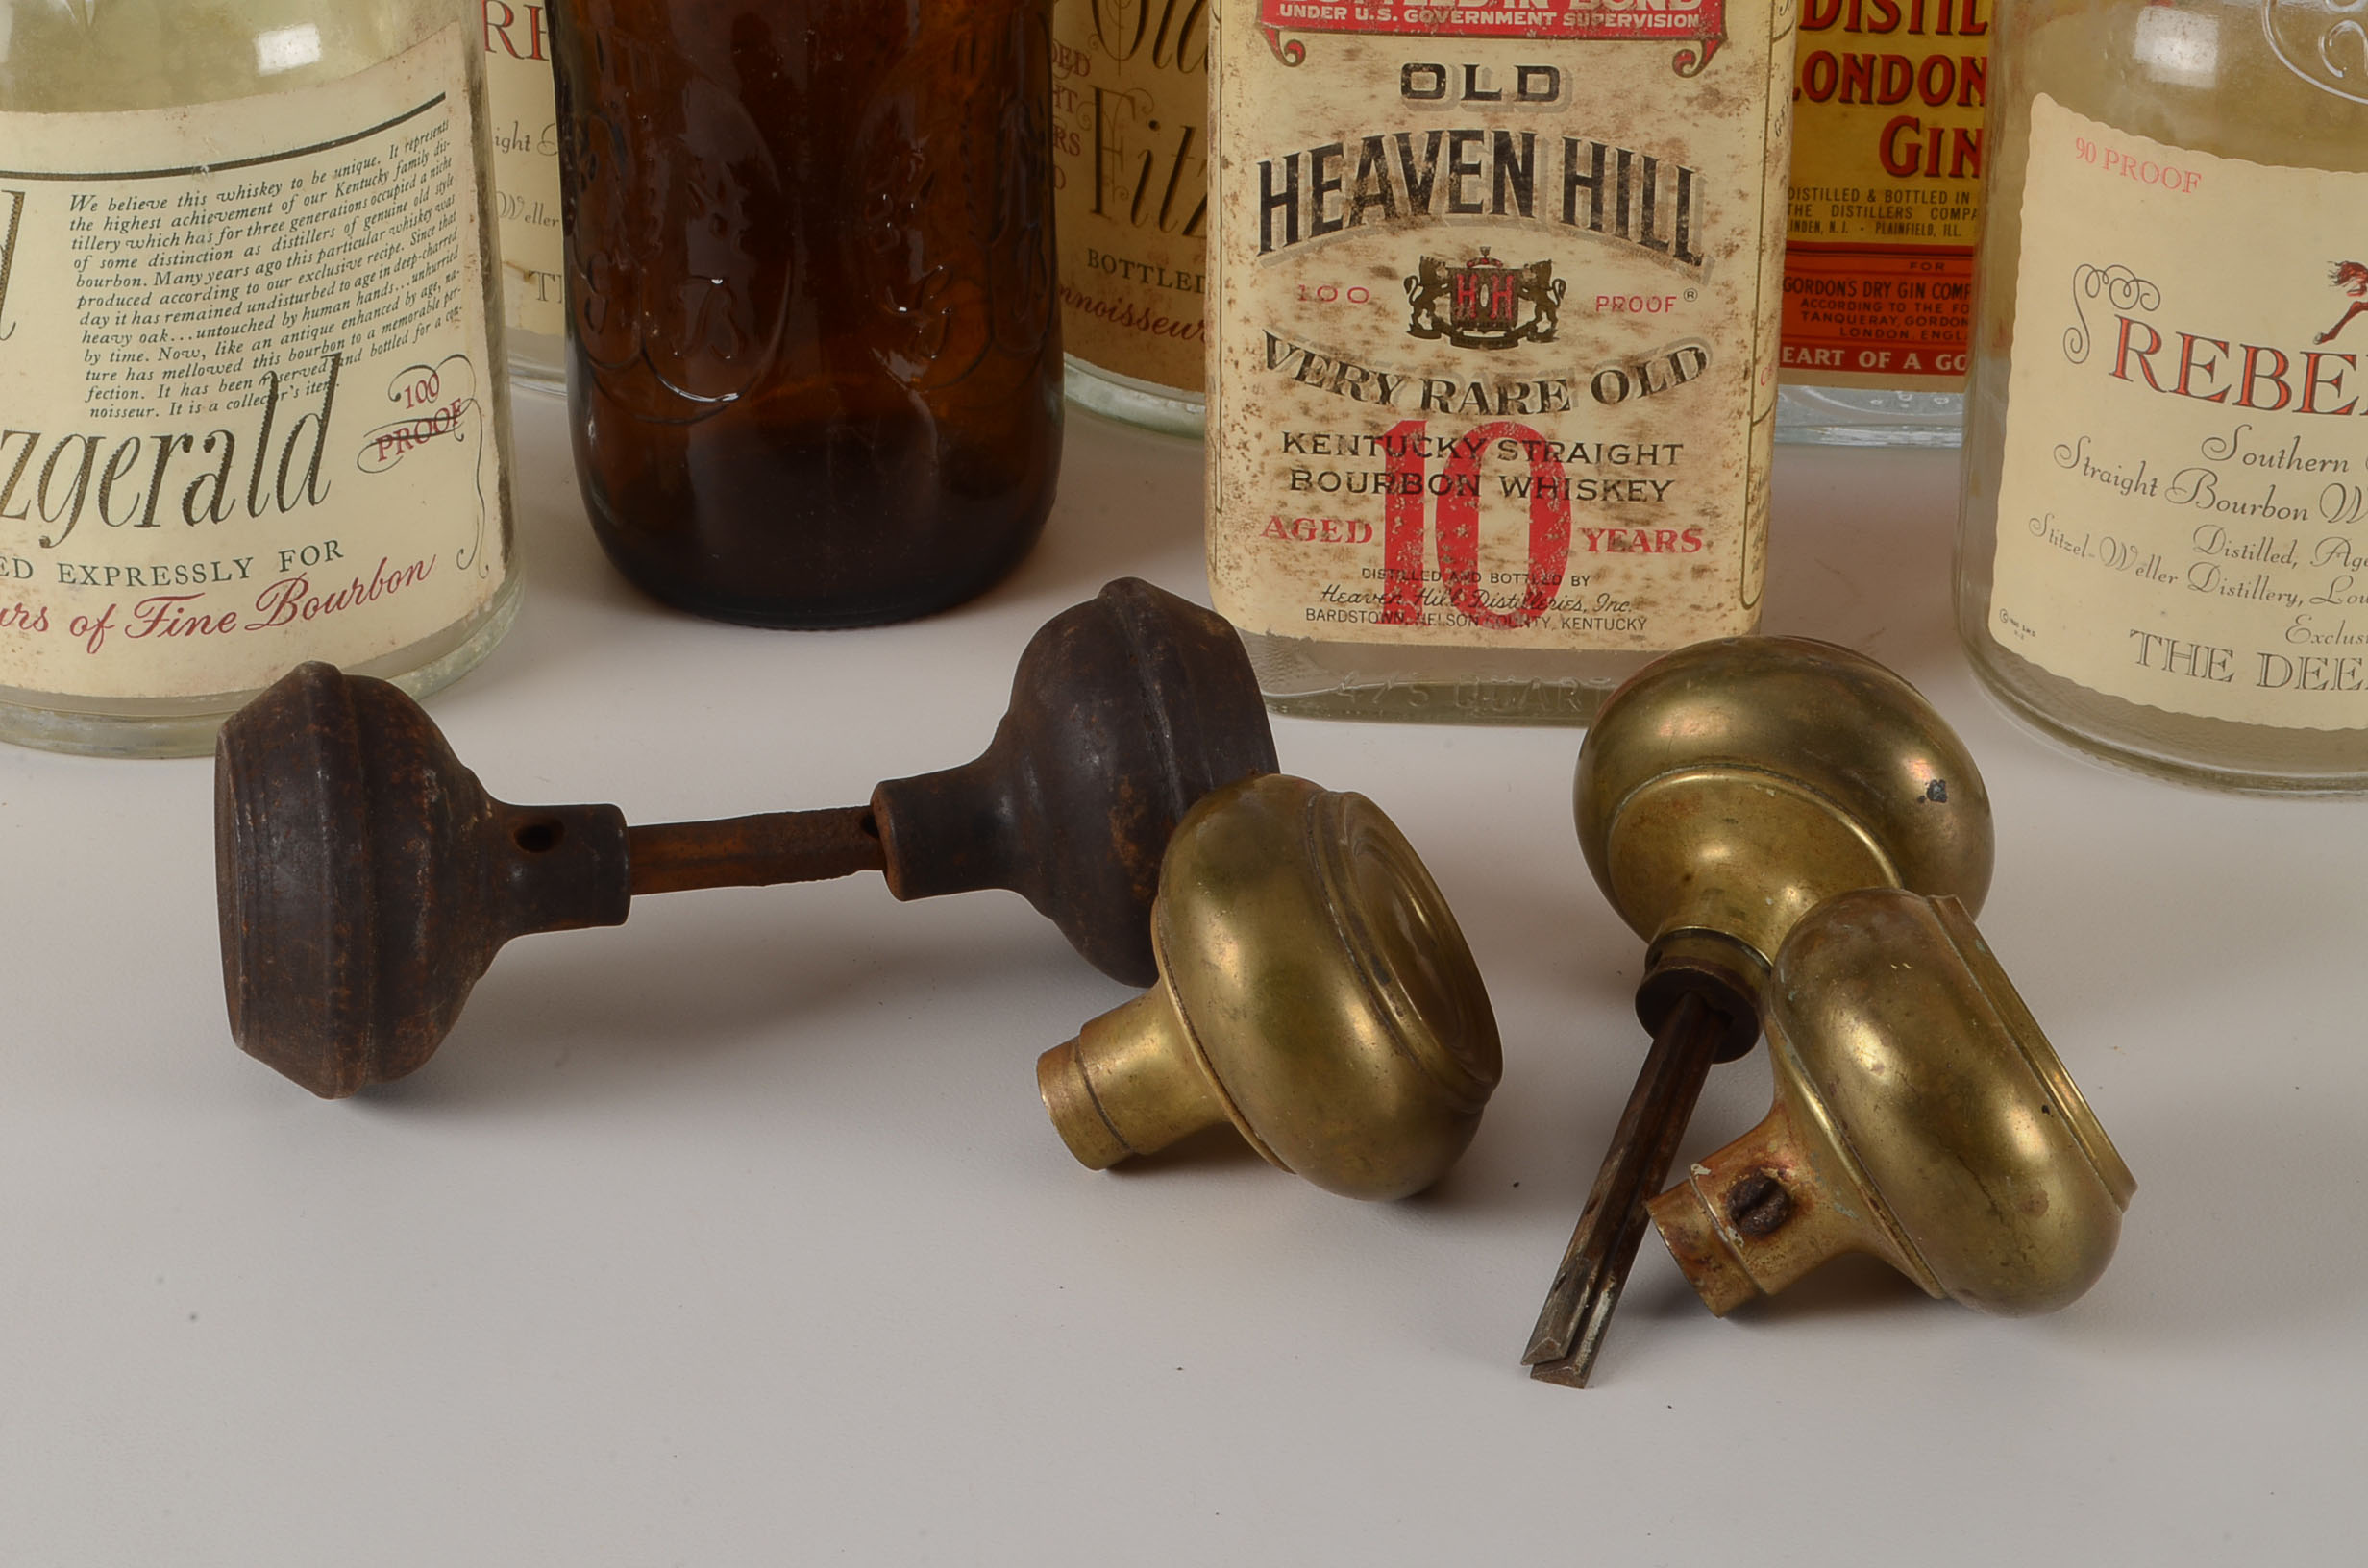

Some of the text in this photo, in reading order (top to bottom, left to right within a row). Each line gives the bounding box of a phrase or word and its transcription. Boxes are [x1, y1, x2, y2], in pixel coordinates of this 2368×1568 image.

[1279, 4, 1347, 20] UNDER
[1355, 8, 1398, 22] U.S.
[1403, 9, 1557, 26] GOVERNMENT
[1563, 12, 1700, 28] SUPERVISION
[1400, 62, 1561, 103] OLD
[1793, 50, 1987, 108] ONDON
[69, 119, 449, 212] We believe this whiskey be unique. represents
[2074, 137, 2203, 193] 90 PROOF
[69, 149, 429, 234] the highest achievement of our Kentucky family
[71, 174, 415, 253] tillery which has for three generations occupied
[1256, 129, 1703, 267] HEAVEN HILL
[1788, 187, 1969, 205] DISTILLED & BOTTLED IN
[1788, 205, 1912, 219] THE DISTILLERS
[74, 189, 429, 272] of some distinction as distillers of genuine old
[76, 207, 432, 287] bourbon. Many years ago this particular whiskey
[77, 211, 456, 309] produced according our exclusive recipe. Since that
[1910, 262, 1945, 271] FOR
[80, 273, 376, 328] day it has remained undisturbed age
[1297, 282, 1371, 305] 100
[1595, 295, 1677, 313] PROOF
[1801, 298, 1883, 312] ACCORDING
[1890, 303, 1906, 312] TO
[1914, 303, 1942, 314] THE
[1863, 281, 1891, 298] DRY
[1898, 282, 1925, 299] GIN
[81, 300, 350, 347] heavy human
[84, 299, 399, 365] by time. Now, like an antique enhanced
[86, 298, 440, 381] ture has mellowed this bourbon memorable
[85, 329, 408, 403] fection. It has been bottled
[1262, 329, 1707, 416] VERY RARE OLD
[1859, 351, 1891, 369] OF
[1904, 353, 1921, 369] A
[2108, 313, 2368, 417] REBE
[90, 404, 160, 418] noisseur.
[403, 373, 441, 410] 100
[377, 397, 464, 463] PROOF
[1281, 431, 1684, 467] KENTUCKY STRAIGHT
[2201, 424, 2350, 474] Southern
[1290, 470, 1676, 502] BOURBON WHISKEY
[2053, 435, 2159, 498] Straight
[2164, 467, 2309, 522] Bourbon
[1259, 419, 1703, 630] AGED 10 YEARS
[2192, 524, 2299, 570] Distilled,
[57, 556, 255, 587] EXPRESSLY
[279, 539, 345, 572] FOR
[1362, 568, 1591, 587] DISTILLED AND BOTTLED BY
[2187, 561, 2305, 608] Distillery,
[70, 603, 118, 655] of
[124, 592, 237, 639] Fine
[244, 554, 437, 630] Bourbon
[1321, 584, 1632, 613] Heaven Hill Distilleries, Inc.
[1562, 617, 1647, 630] KENTUCKY
[2130, 628, 2235, 683] THE
